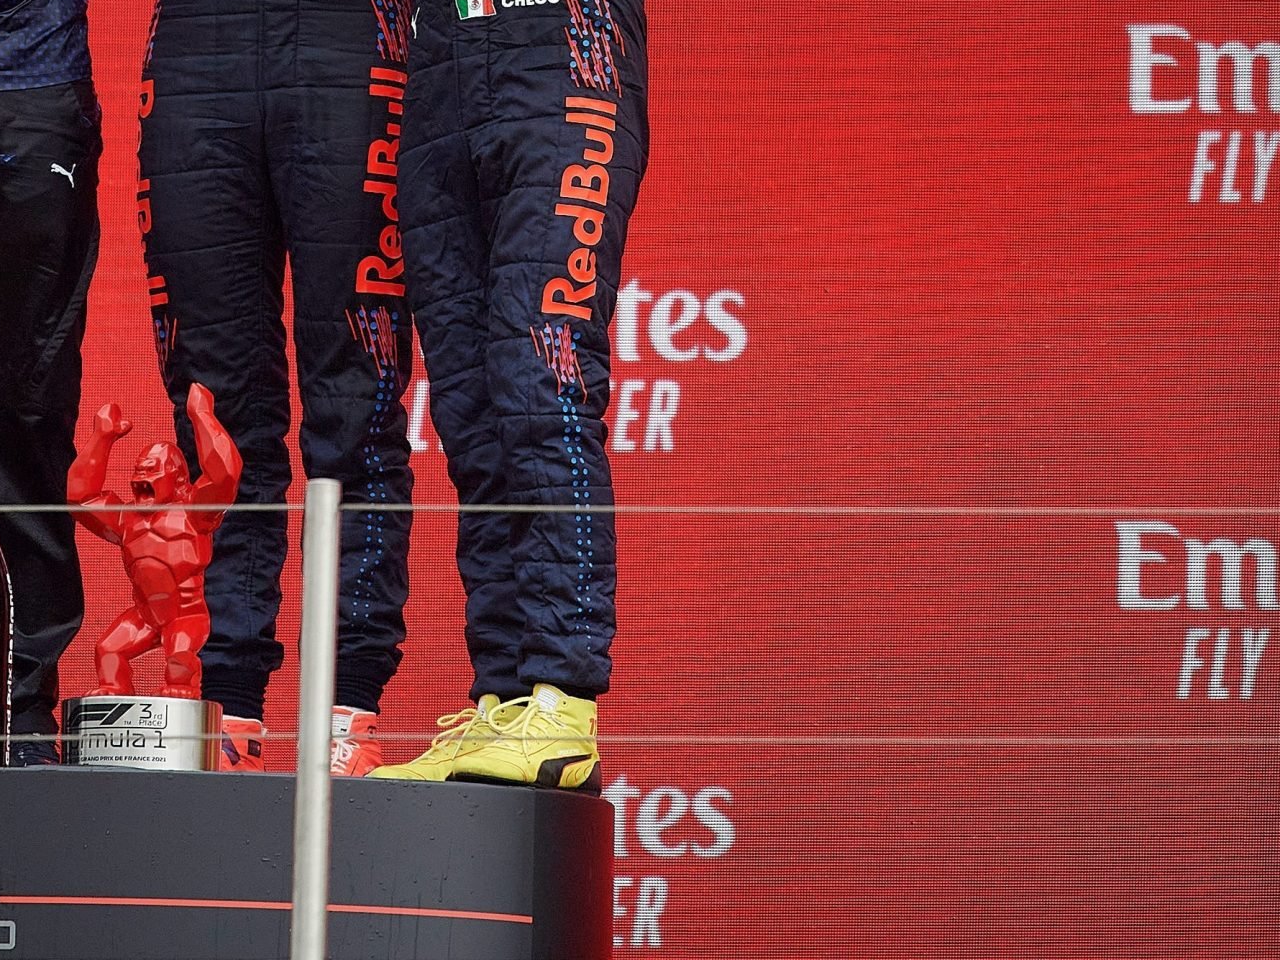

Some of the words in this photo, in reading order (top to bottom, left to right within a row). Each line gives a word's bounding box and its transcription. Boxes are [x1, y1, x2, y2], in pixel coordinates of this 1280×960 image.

[559, 96, 618, 206] Bull
[1188, 129, 1280, 203] FLY
[541, 203, 606, 321] Red
[1175, 627, 1272, 700] FLY
[72, 730, 146, 749] rmula
[154, 730, 167, 749] 1
[139, 704, 163, 720] 3rd
